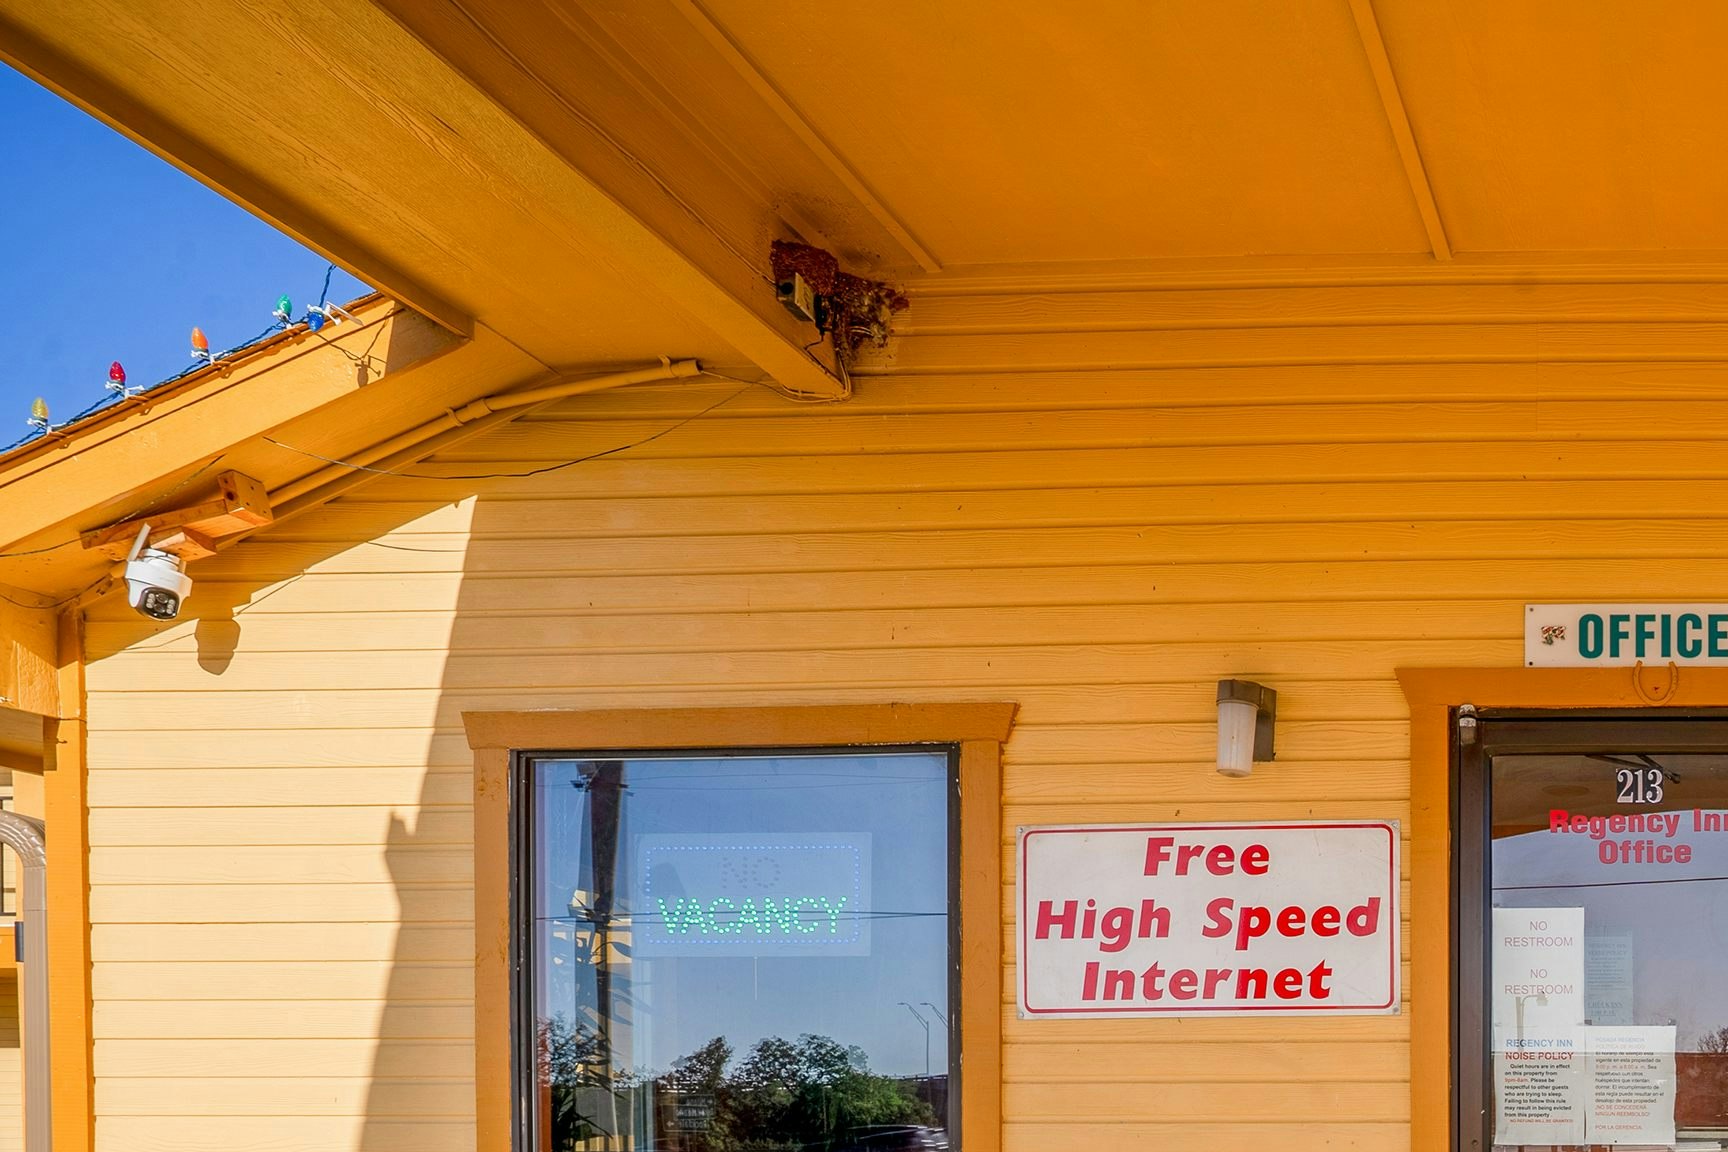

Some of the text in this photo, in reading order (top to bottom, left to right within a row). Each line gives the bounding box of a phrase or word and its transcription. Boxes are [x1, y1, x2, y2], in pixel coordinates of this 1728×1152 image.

[1616, 768, 1664, 804] 213
[1549, 809, 1680, 840] Regency
[1143, 836, 1270, 876] Free
[1598, 839, 1692, 865] Office
[722, 856, 781, 889] NO
[657, 896, 847, 934] VACANCY
[1034, 896, 1381, 953] High Speed
[1529, 920, 1548, 931] NO
[1504, 936, 1573, 947] RESTROOM
[1081, 959, 1333, 1000] Internet
[1530, 968, 1548, 979] NO
[1504, 984, 1573, 995] RESTROOM
[1505, 1039, 1573, 1048] REGENCY INN
[1505, 1052, 1574, 1060] NOISE POLICY
